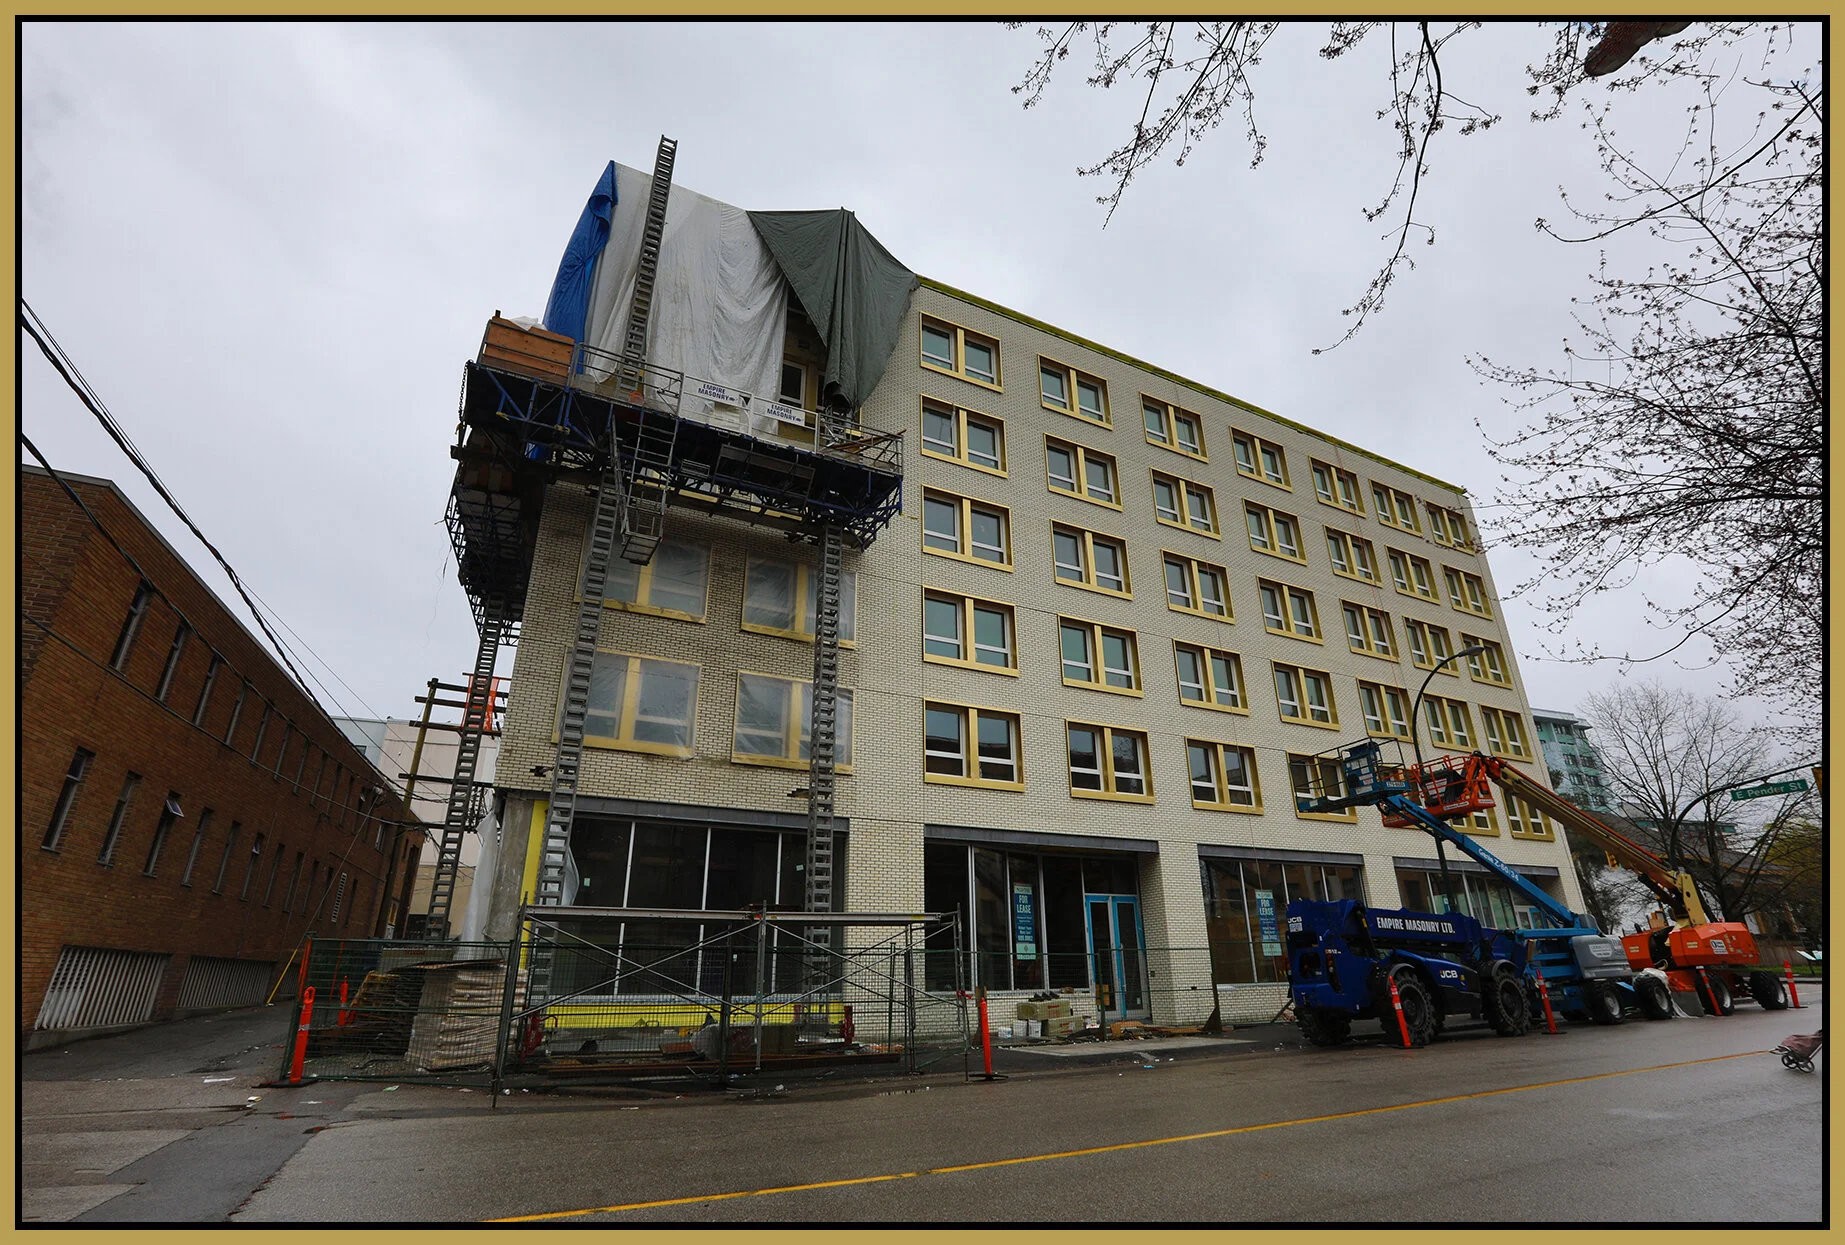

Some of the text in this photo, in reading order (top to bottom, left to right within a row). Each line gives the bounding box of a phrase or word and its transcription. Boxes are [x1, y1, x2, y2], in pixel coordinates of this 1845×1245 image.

[698, 388, 729, 400] MASONRY
[702, 384, 725, 394] EMPIRE
[767, 408, 796, 420] MASONRY
[771, 404, 792, 414] EMPIRE
[1747, 785, 1785, 798] Pender
[1789, 782, 1803, 791] St
[1019, 895, 1028, 903] FOR
[1260, 899, 1270, 907] FOR
[1017, 904, 1031, 913] LEASE
[1259, 908, 1274, 916] LEASE
[1376, 917, 1456, 934] EMPIRE MASONRY LTD.
[1439, 969, 1458, 979] JCB
